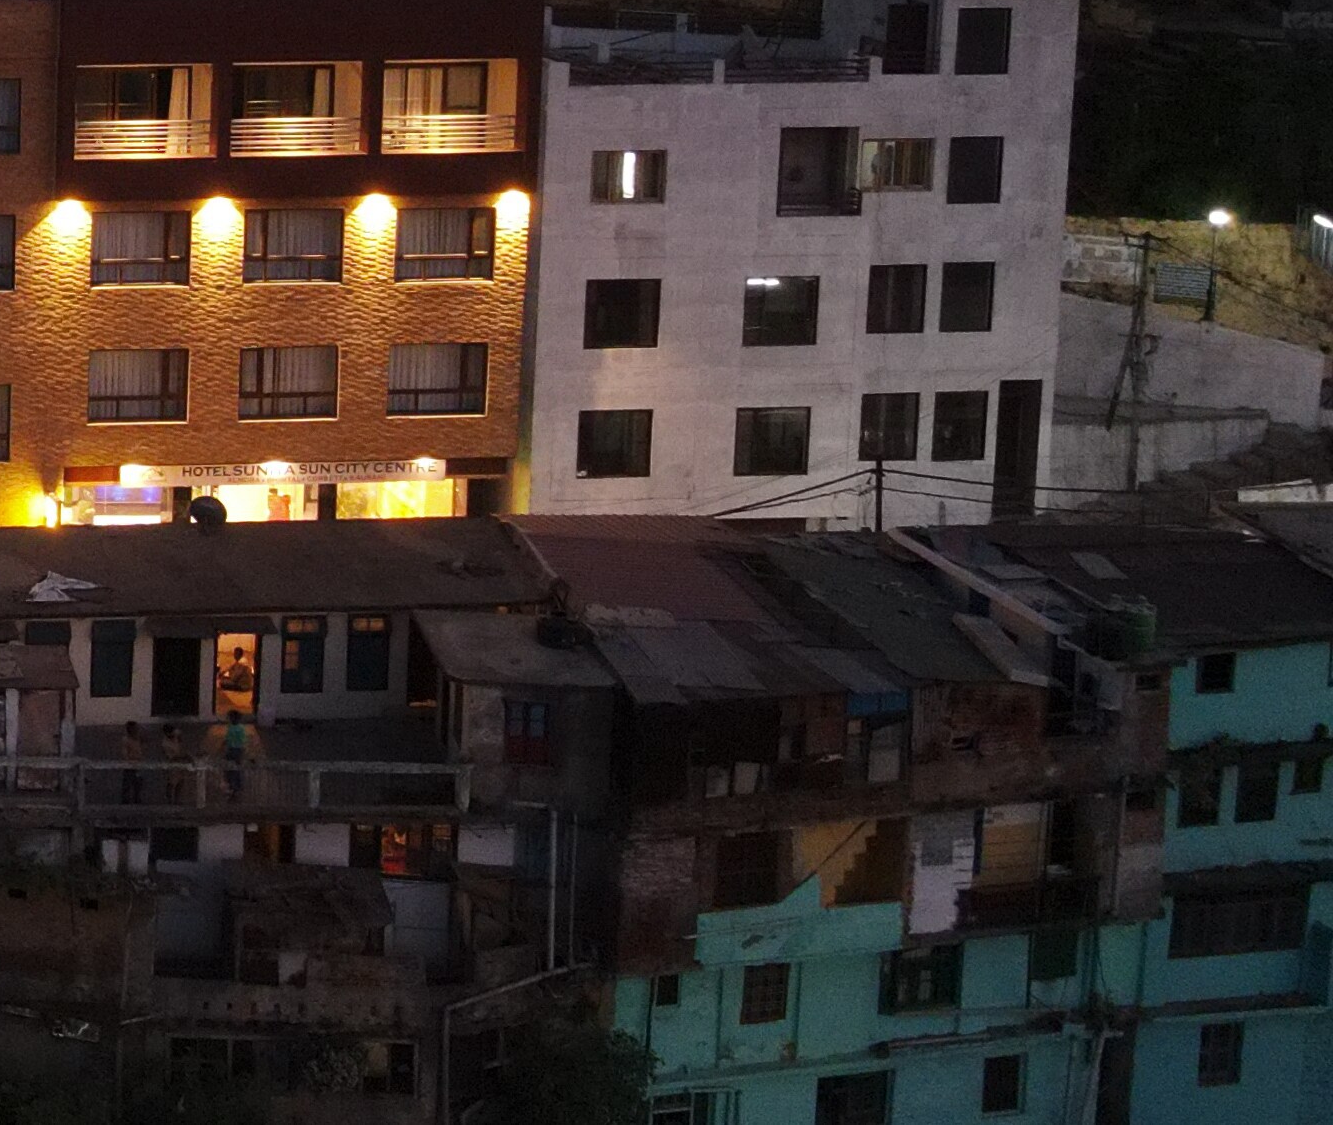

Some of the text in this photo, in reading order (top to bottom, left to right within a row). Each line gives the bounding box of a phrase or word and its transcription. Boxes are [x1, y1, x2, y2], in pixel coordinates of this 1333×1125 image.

[182, 466, 231, 477] HOTEL
[299, 463, 331, 475] SUN
[334, 462, 370, 474] CITY
[374, 462, 437, 474] CENTRE
